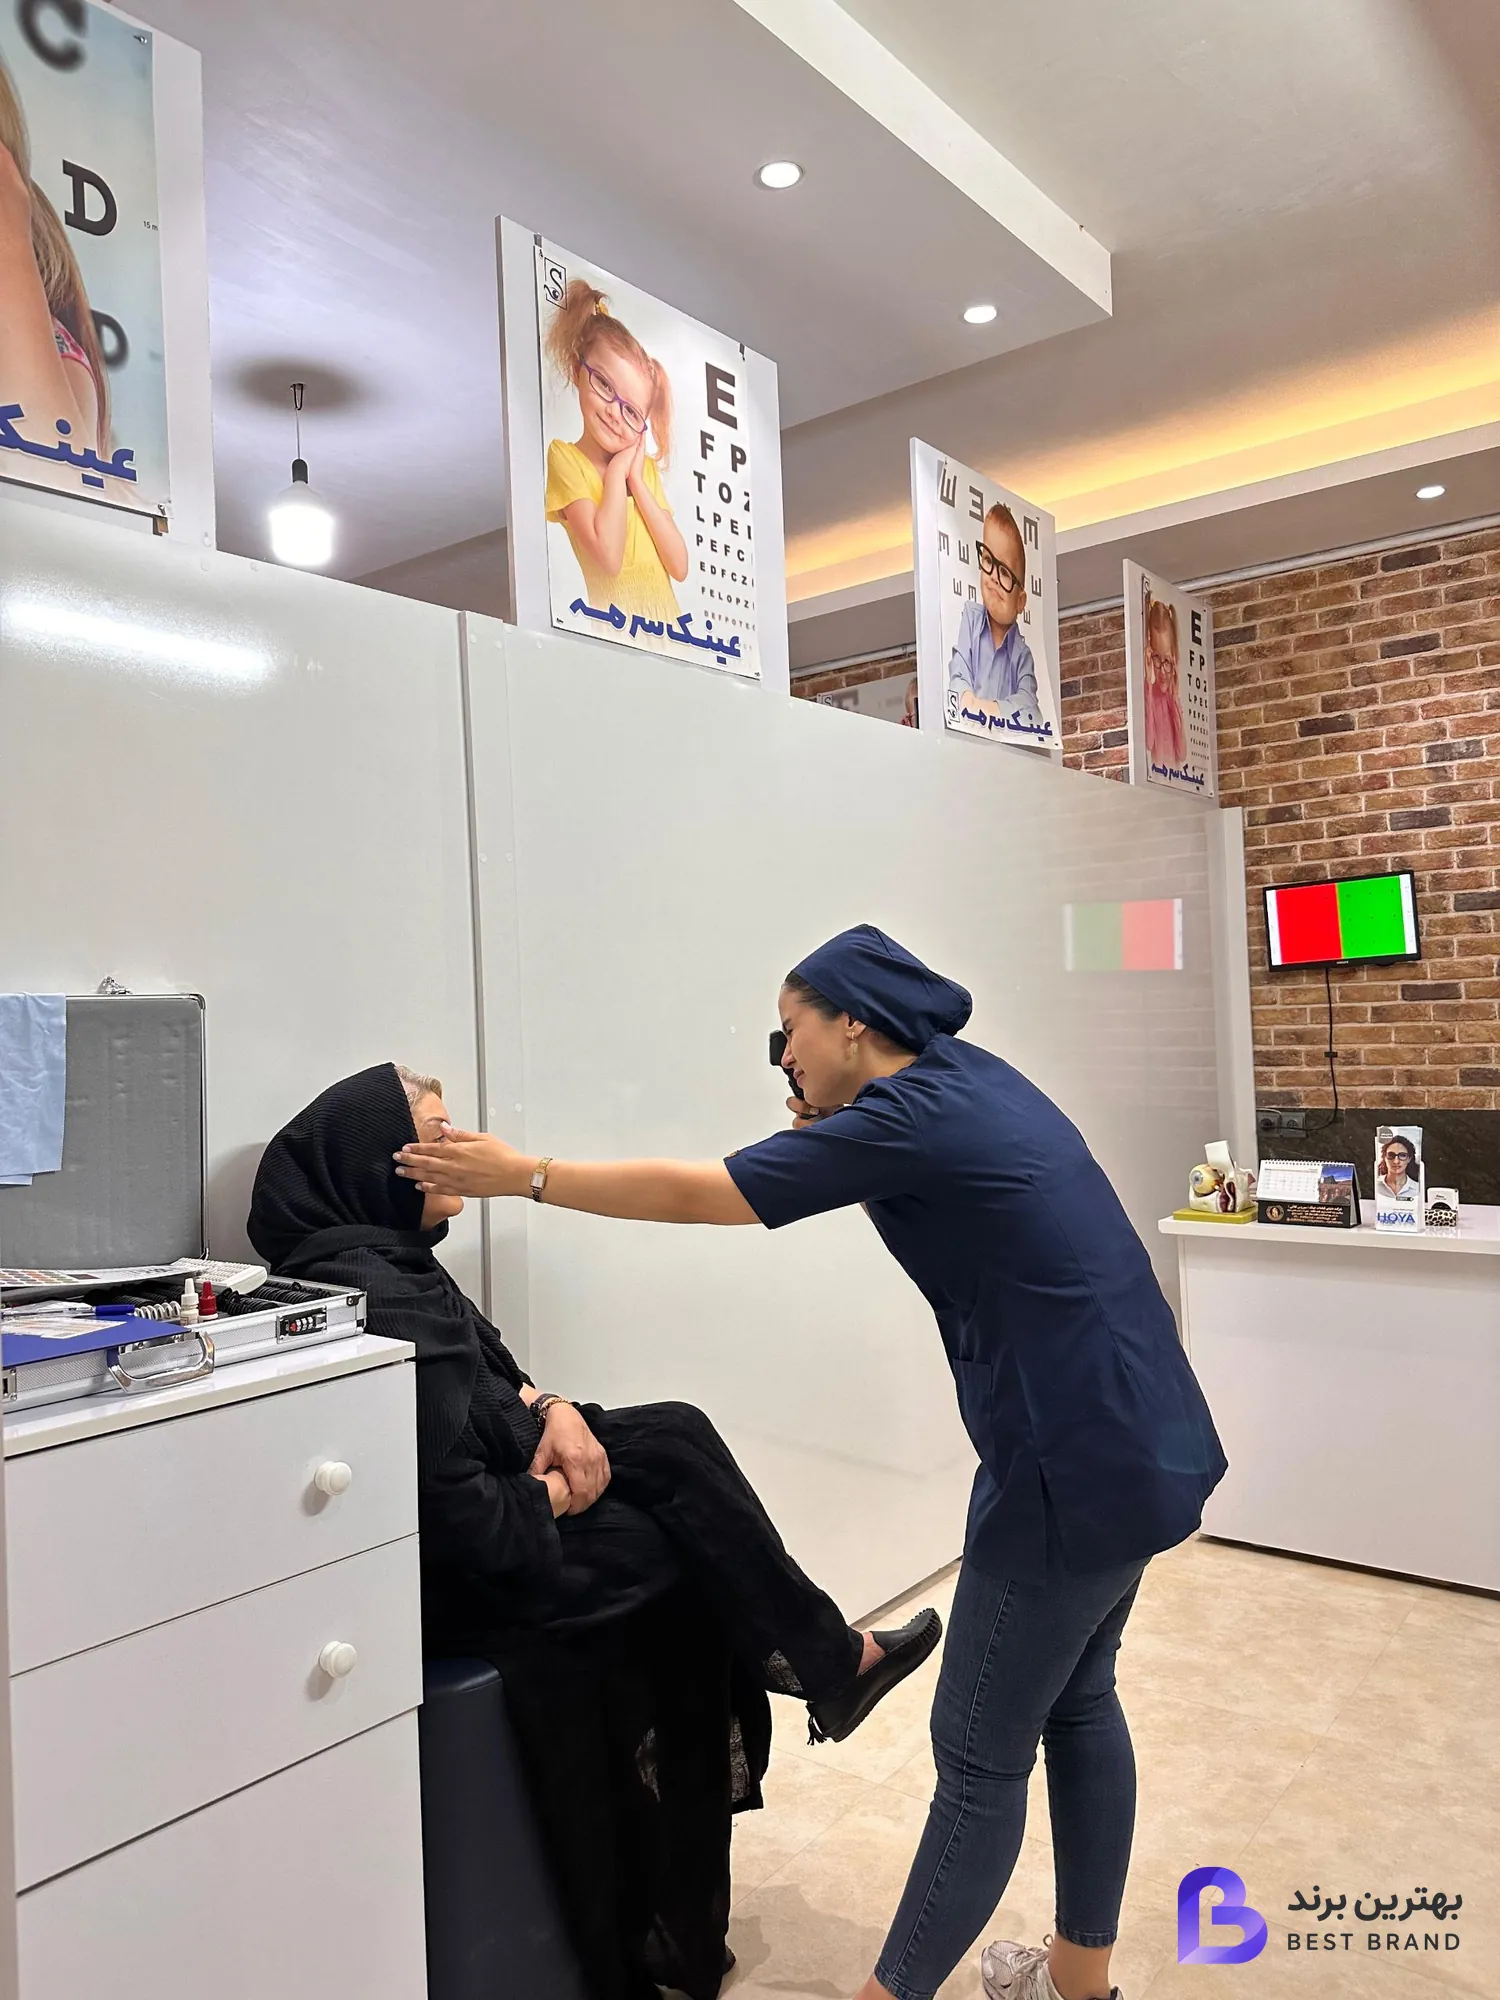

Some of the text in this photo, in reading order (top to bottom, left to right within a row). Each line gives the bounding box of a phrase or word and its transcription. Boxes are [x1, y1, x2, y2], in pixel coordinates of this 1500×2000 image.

[63, 159, 117, 236] D
[143, 220, 151, 229] 15
[705, 361, 737, 430] E
[696, 533, 753, 565] PEFC
[700, 561, 754, 587] EDFCZ
[667, 612, 741, 664] عینک
[1191, 609, 1202, 646] E
[1006, 710, 1053, 742] عینک
[1377, 1212, 1415, 1223] HOYA
